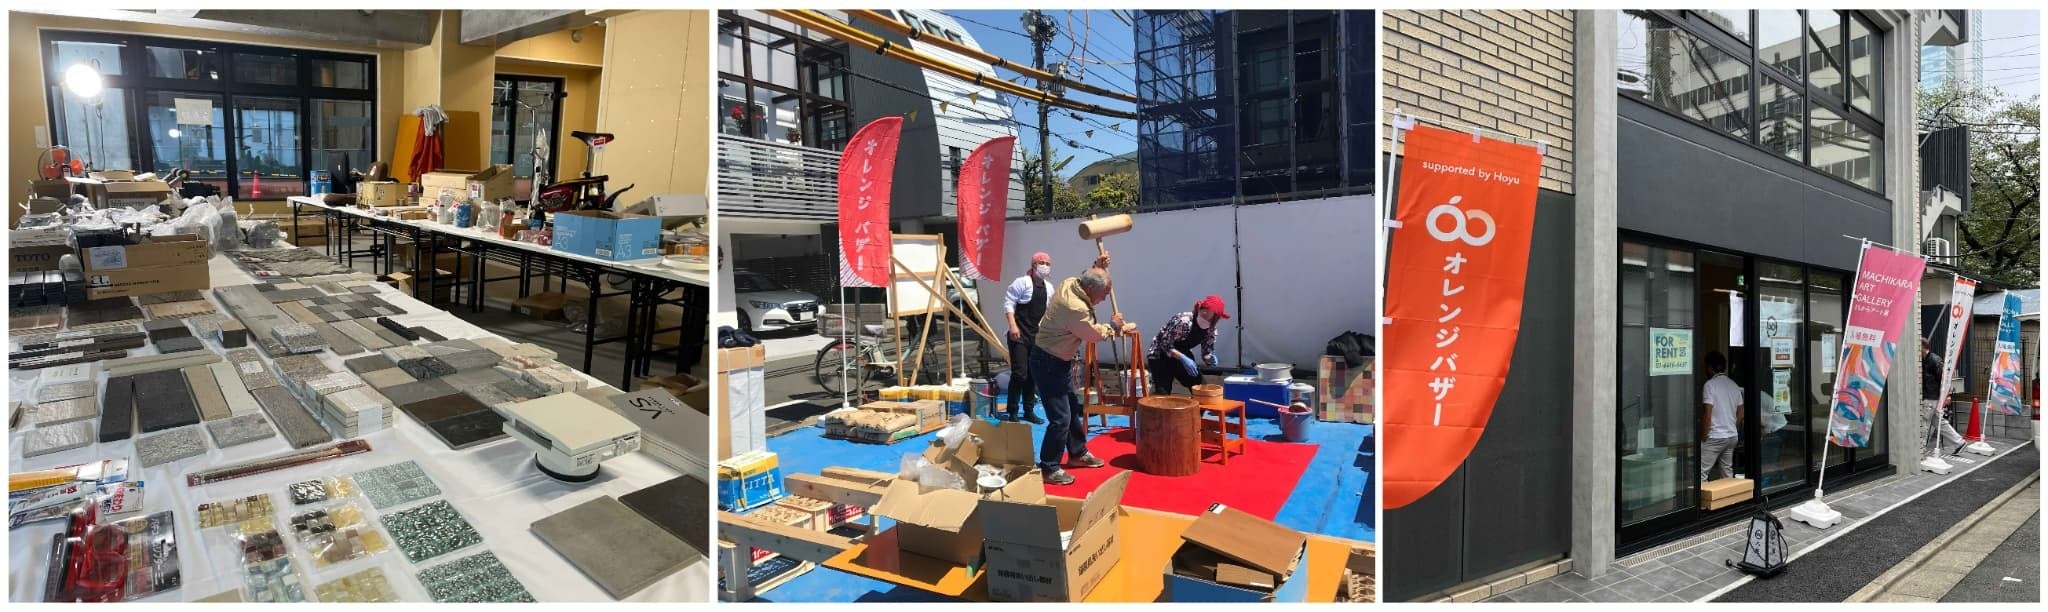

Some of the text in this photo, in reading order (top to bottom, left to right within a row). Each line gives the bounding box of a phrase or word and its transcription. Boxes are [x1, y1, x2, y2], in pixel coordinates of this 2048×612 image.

[1422, 160, 1476, 176] supported
[1478, 168, 1491, 181] by
[1859, 282, 1876, 292] ART
[1862, 270, 1913, 290] MACHIKARA
[1856, 293, 1893, 308] GALLERY
[1428, 252, 1467, 427] オレンジバザー
[1655, 336, 1674, 347] FOR
[1655, 347, 1678, 359] RENT
[744, 474, 775, 490] ITTA
